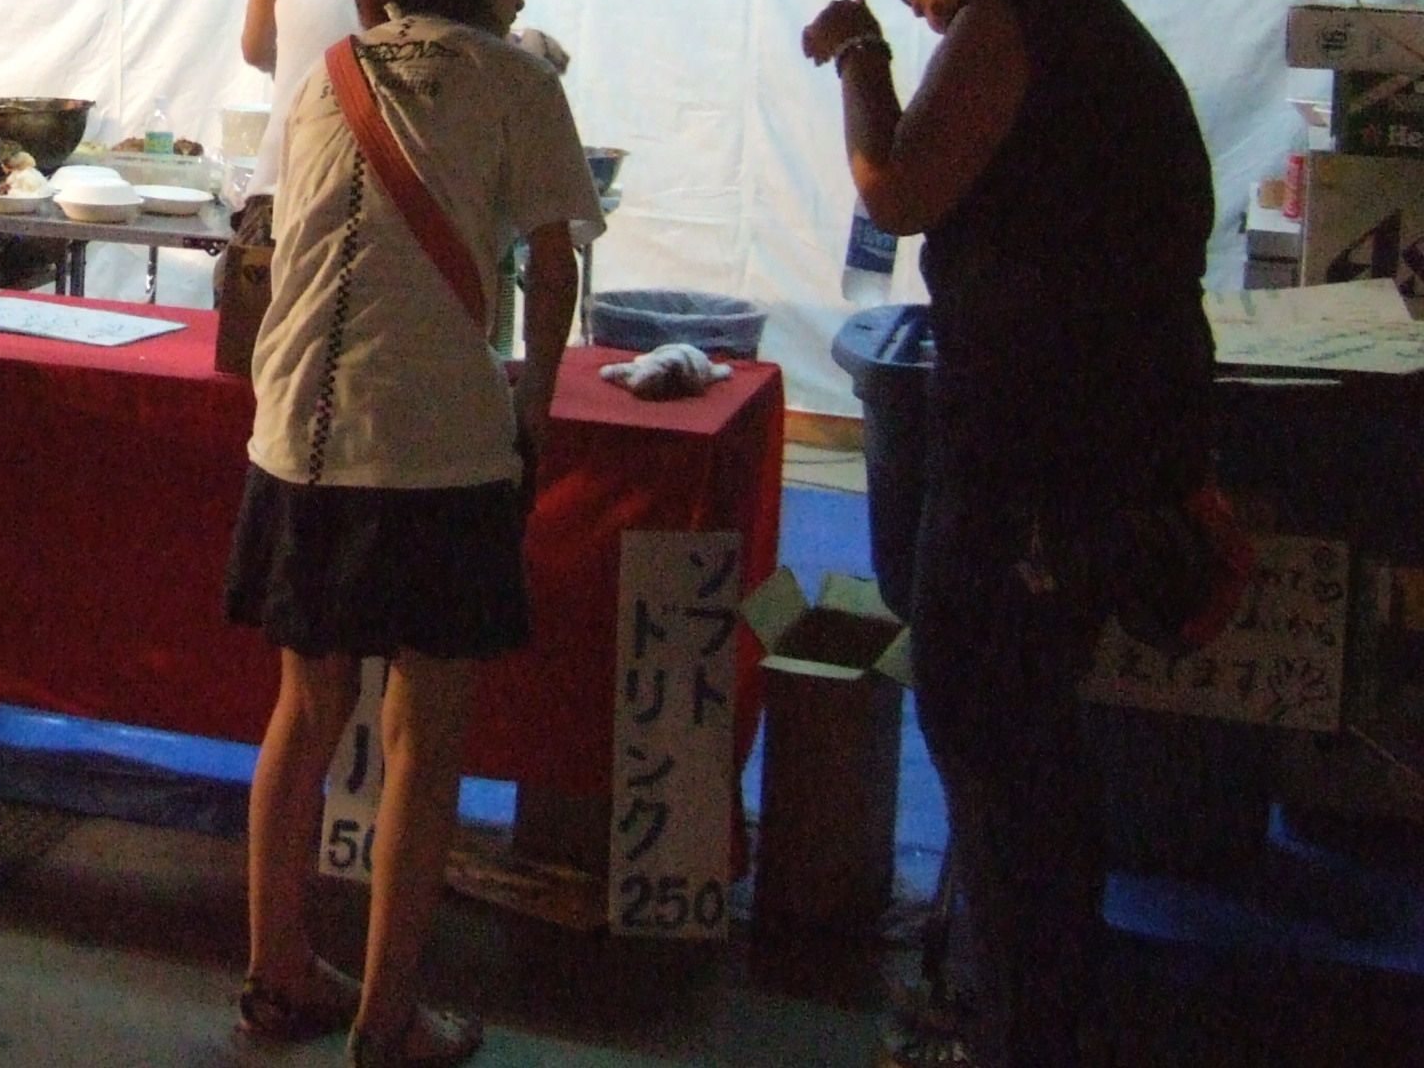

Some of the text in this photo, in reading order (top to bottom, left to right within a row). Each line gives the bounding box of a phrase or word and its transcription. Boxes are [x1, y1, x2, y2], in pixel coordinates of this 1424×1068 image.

[685, 548, 738, 726] ソフト
[619, 598, 676, 863] ドリンク
[327, 817, 376, 874] 5
[620, 874, 725, 930] 250
